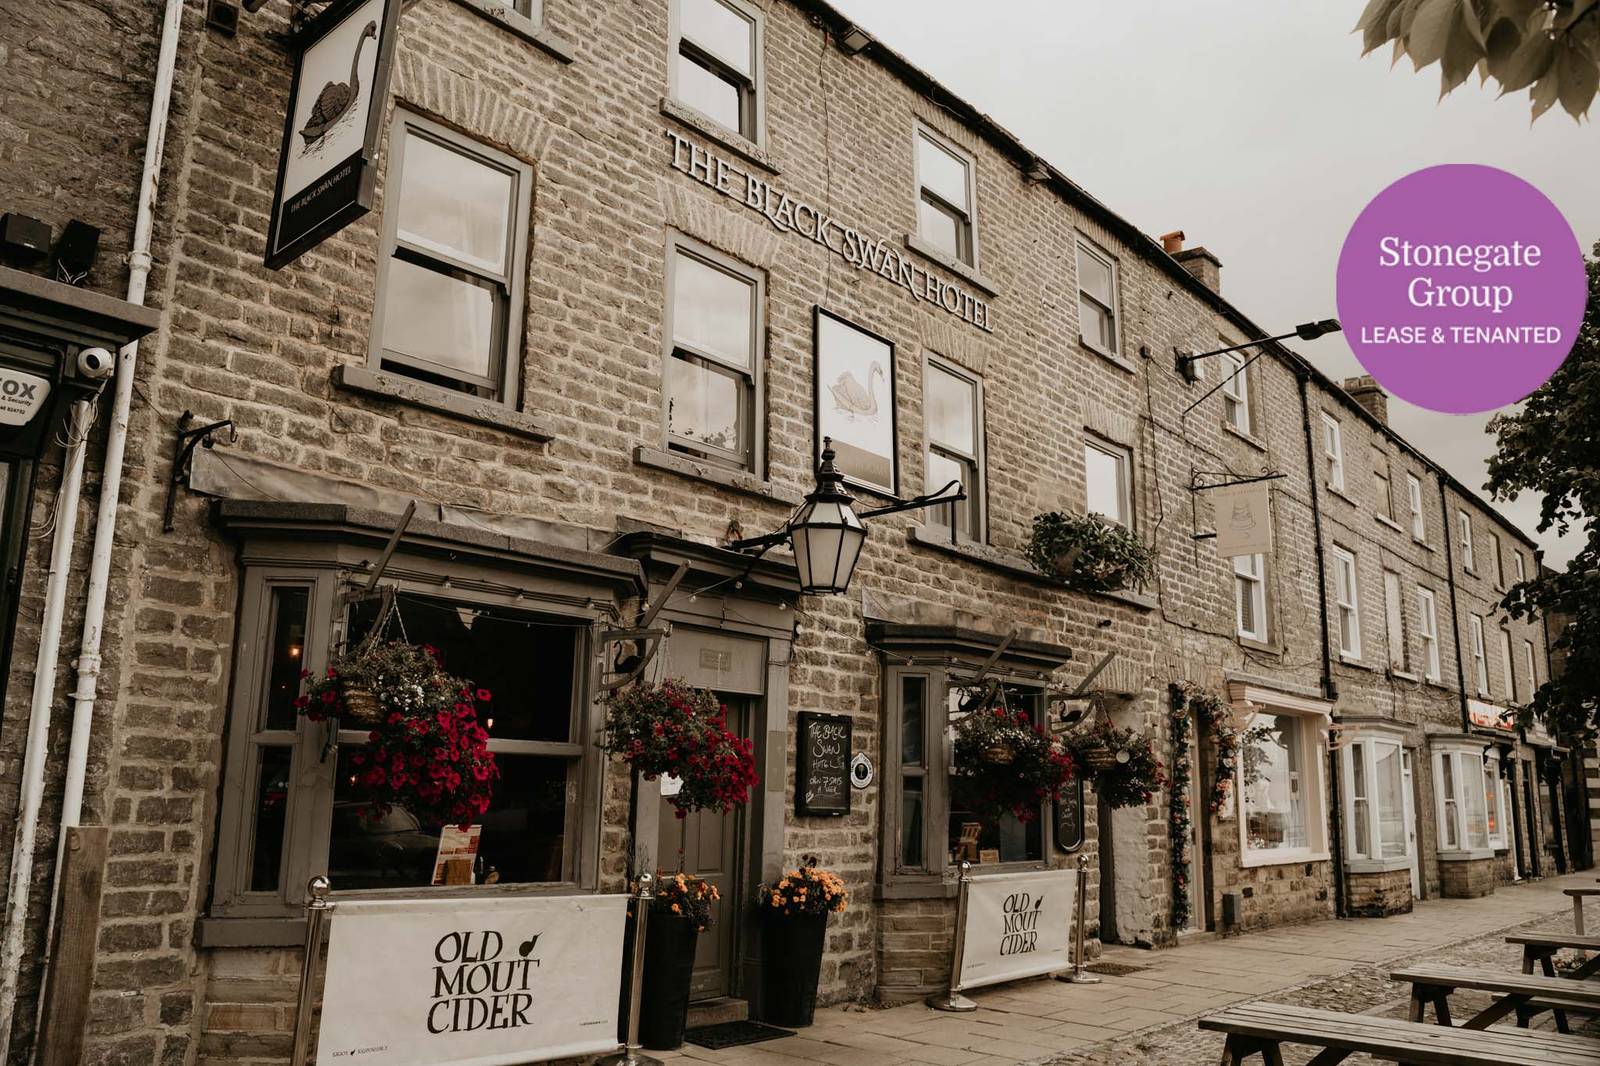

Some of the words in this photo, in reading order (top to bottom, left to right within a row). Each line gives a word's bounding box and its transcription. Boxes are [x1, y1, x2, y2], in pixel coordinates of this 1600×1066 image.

[665, 128, 731, 195] THE
[745, 172, 834, 249] BLACK
[843, 227, 920, 301] SWAN
[925, 270, 993, 333] HOTEL
[0, 378, 37, 400] OX
[7, 396, 32, 406] Security
[1003, 893, 1030, 914] OLD
[1003, 910, 1042, 935] MOUT
[434, 930, 503, 964] OLD
[1000, 931, 1038, 956] CIDER
[430, 958, 540, 998] MOUT
[427, 992, 533, 1034] CIDER
